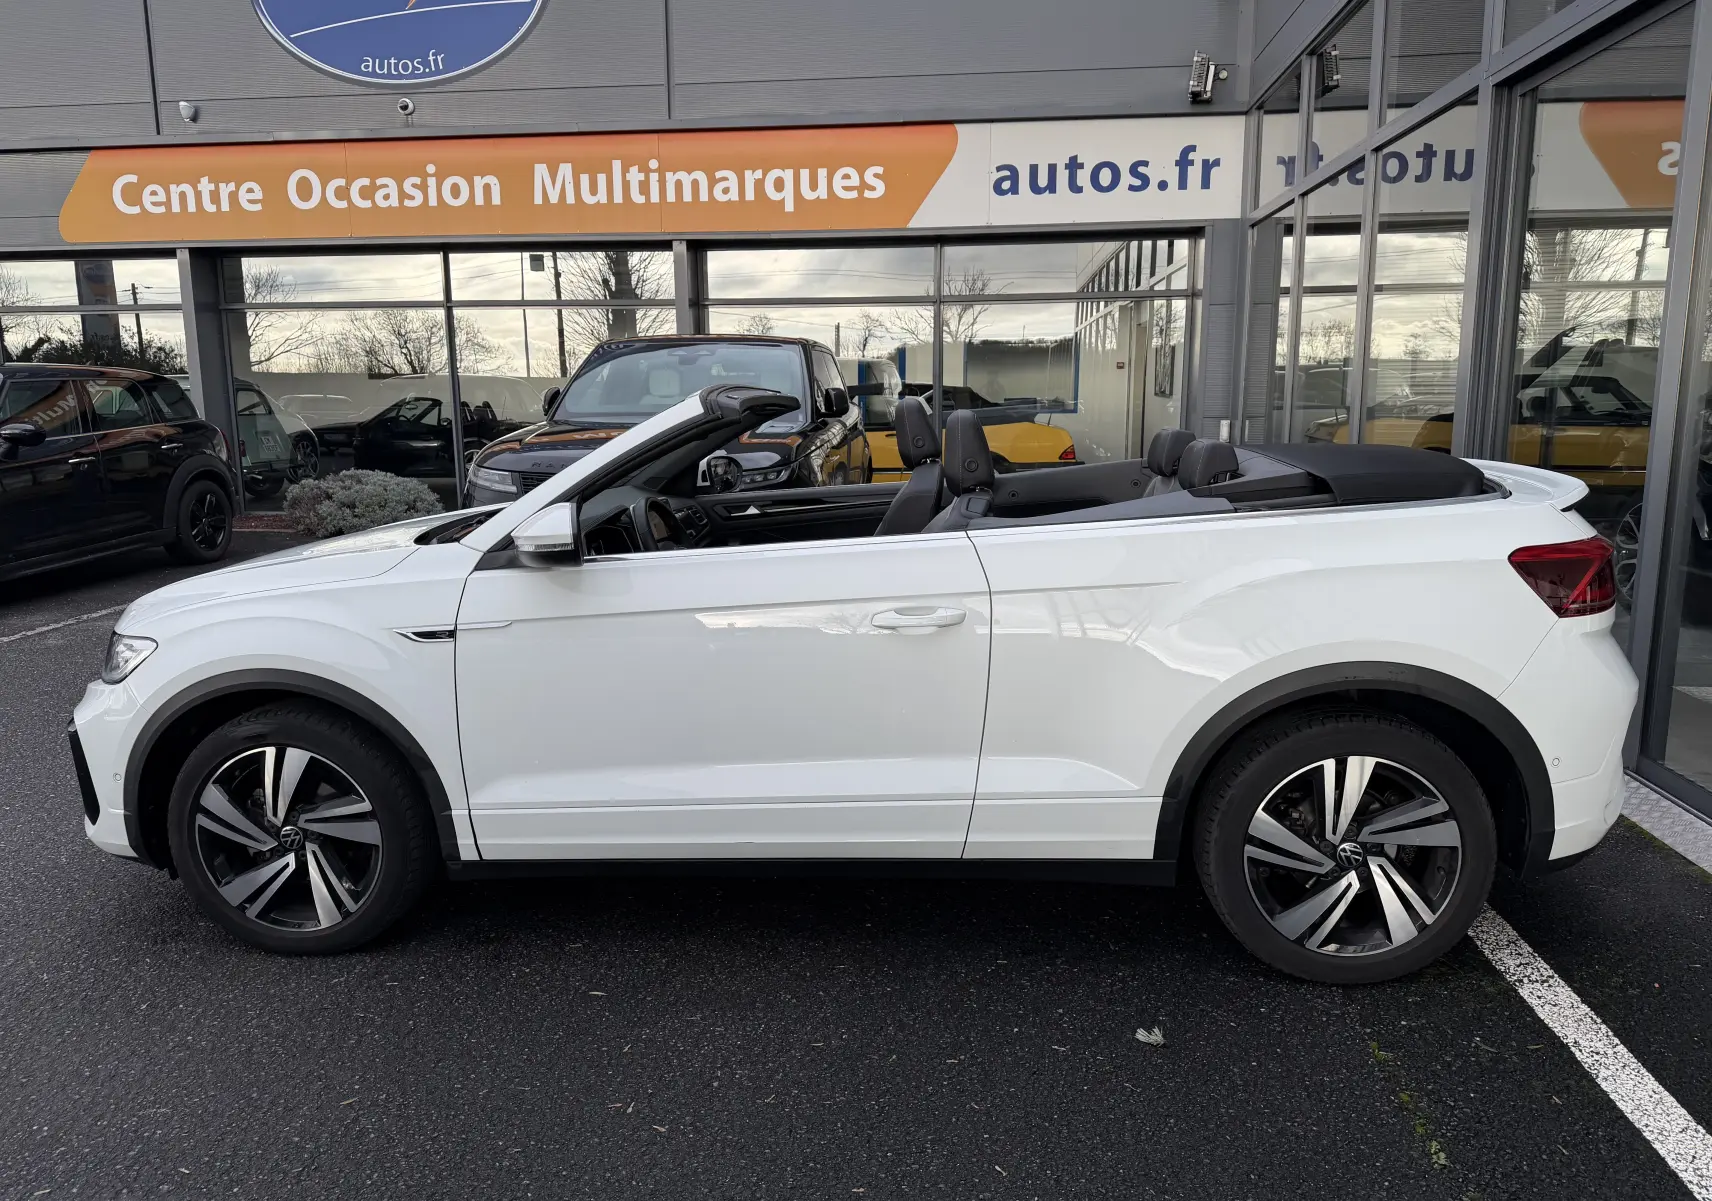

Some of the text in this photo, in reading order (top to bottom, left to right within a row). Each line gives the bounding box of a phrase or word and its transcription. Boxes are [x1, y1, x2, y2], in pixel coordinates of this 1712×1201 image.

[360, 49, 445, 75] autos.fr
[112, 158, 887, 215] Centre Occasion Multimarques
[991, 144, 1221, 197] autos.fr
